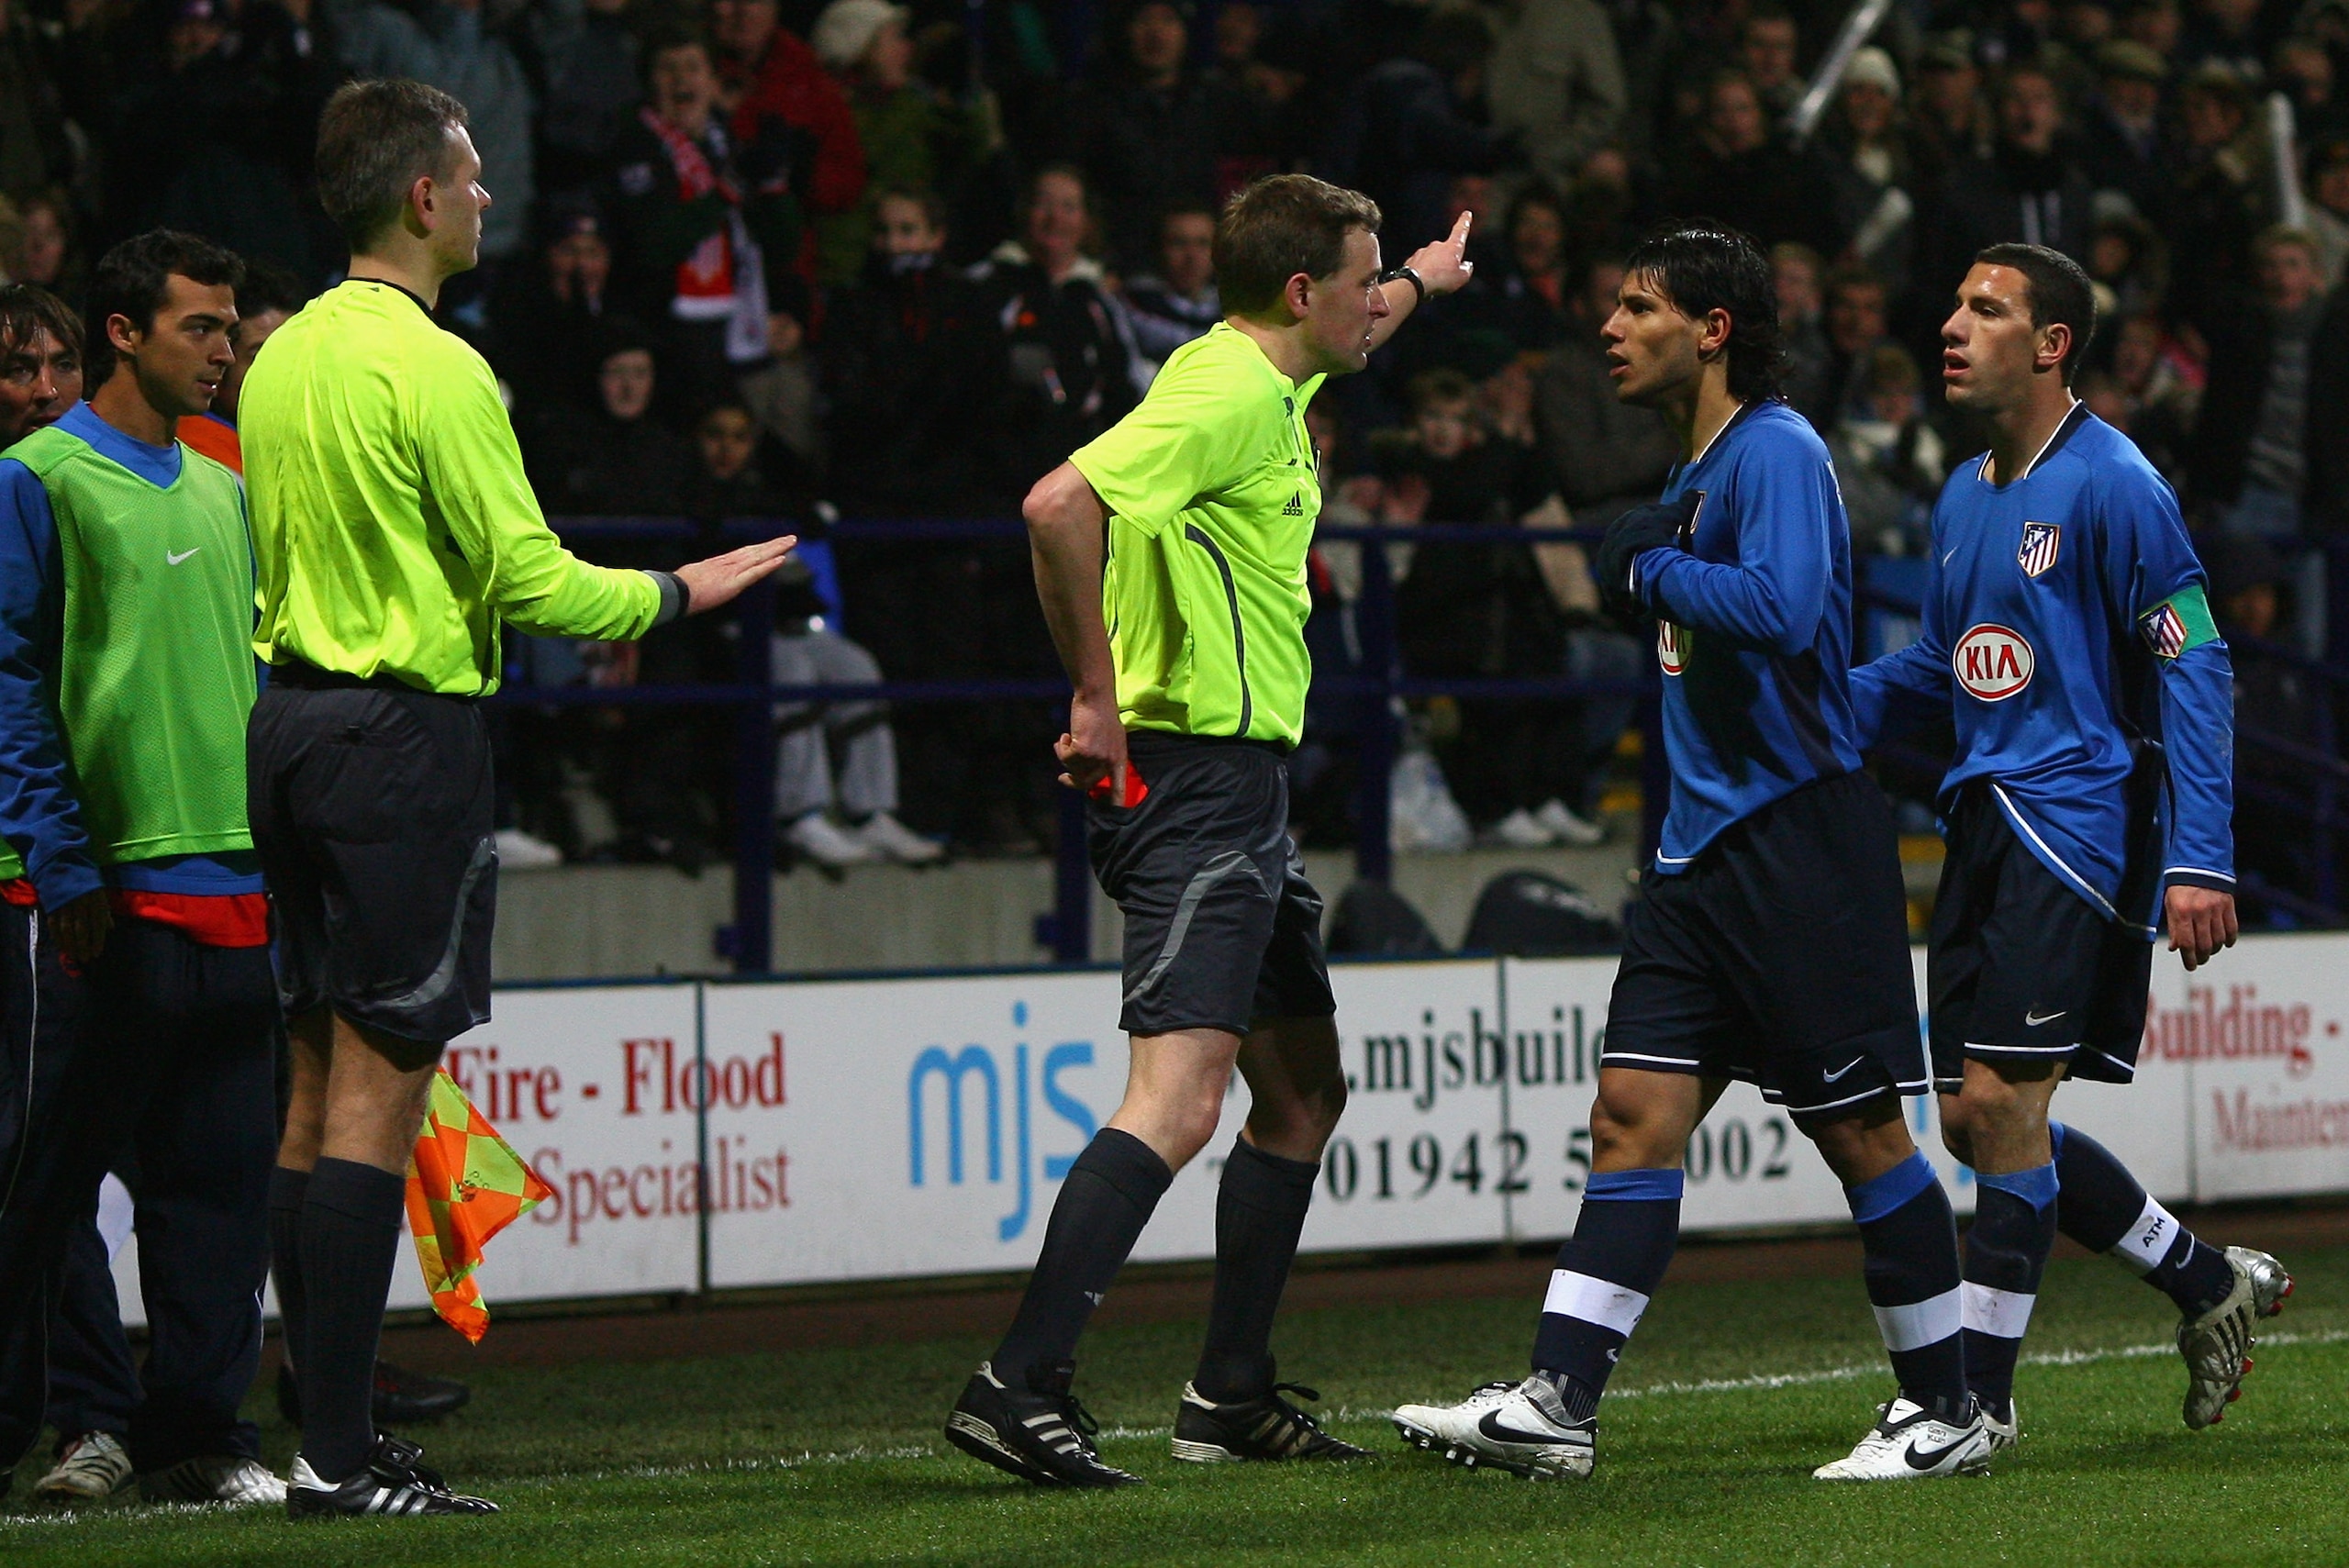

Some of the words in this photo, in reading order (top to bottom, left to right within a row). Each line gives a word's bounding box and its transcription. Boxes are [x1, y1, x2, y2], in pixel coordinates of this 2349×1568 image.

[1965, 644, 2022, 680] KIA
[447, 1045, 562, 1122] Fire
[621, 1031, 786, 1114] Flood
[1345, 1006, 1608, 1112] .mjsbuil
[907, 1000, 1098, 1242] mjs
[1325, 1129, 1531, 1204] 01942
[1562, 1116, 1792, 1192] 5002
[529, 1134, 792, 1247] Specialist
[2142, 1217, 2166, 1248] ATM
